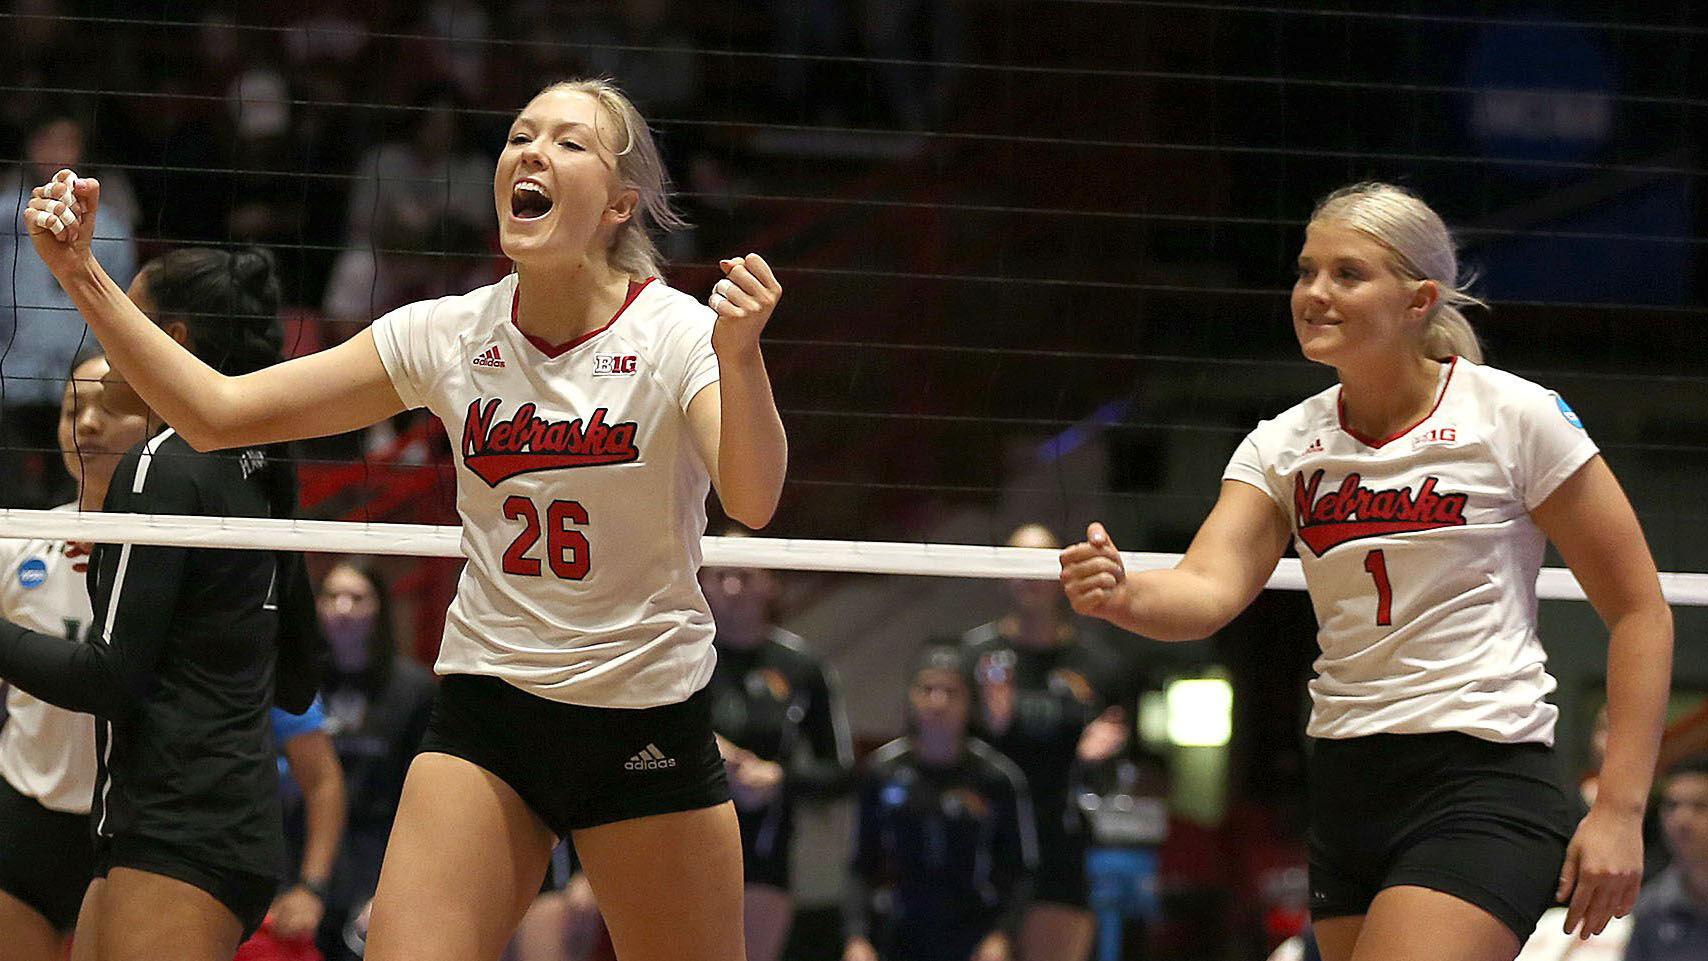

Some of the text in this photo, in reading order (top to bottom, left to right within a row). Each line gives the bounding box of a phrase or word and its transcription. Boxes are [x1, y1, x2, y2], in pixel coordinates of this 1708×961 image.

[473, 357, 505, 368] adidas
[462, 398, 639, 460] Nebraska
[1294, 468, 1468, 527] Nebraska
[502, 495, 591, 581] 26
[1364, 549, 1392, 626] 1
[624, 757, 676, 770] adidas
